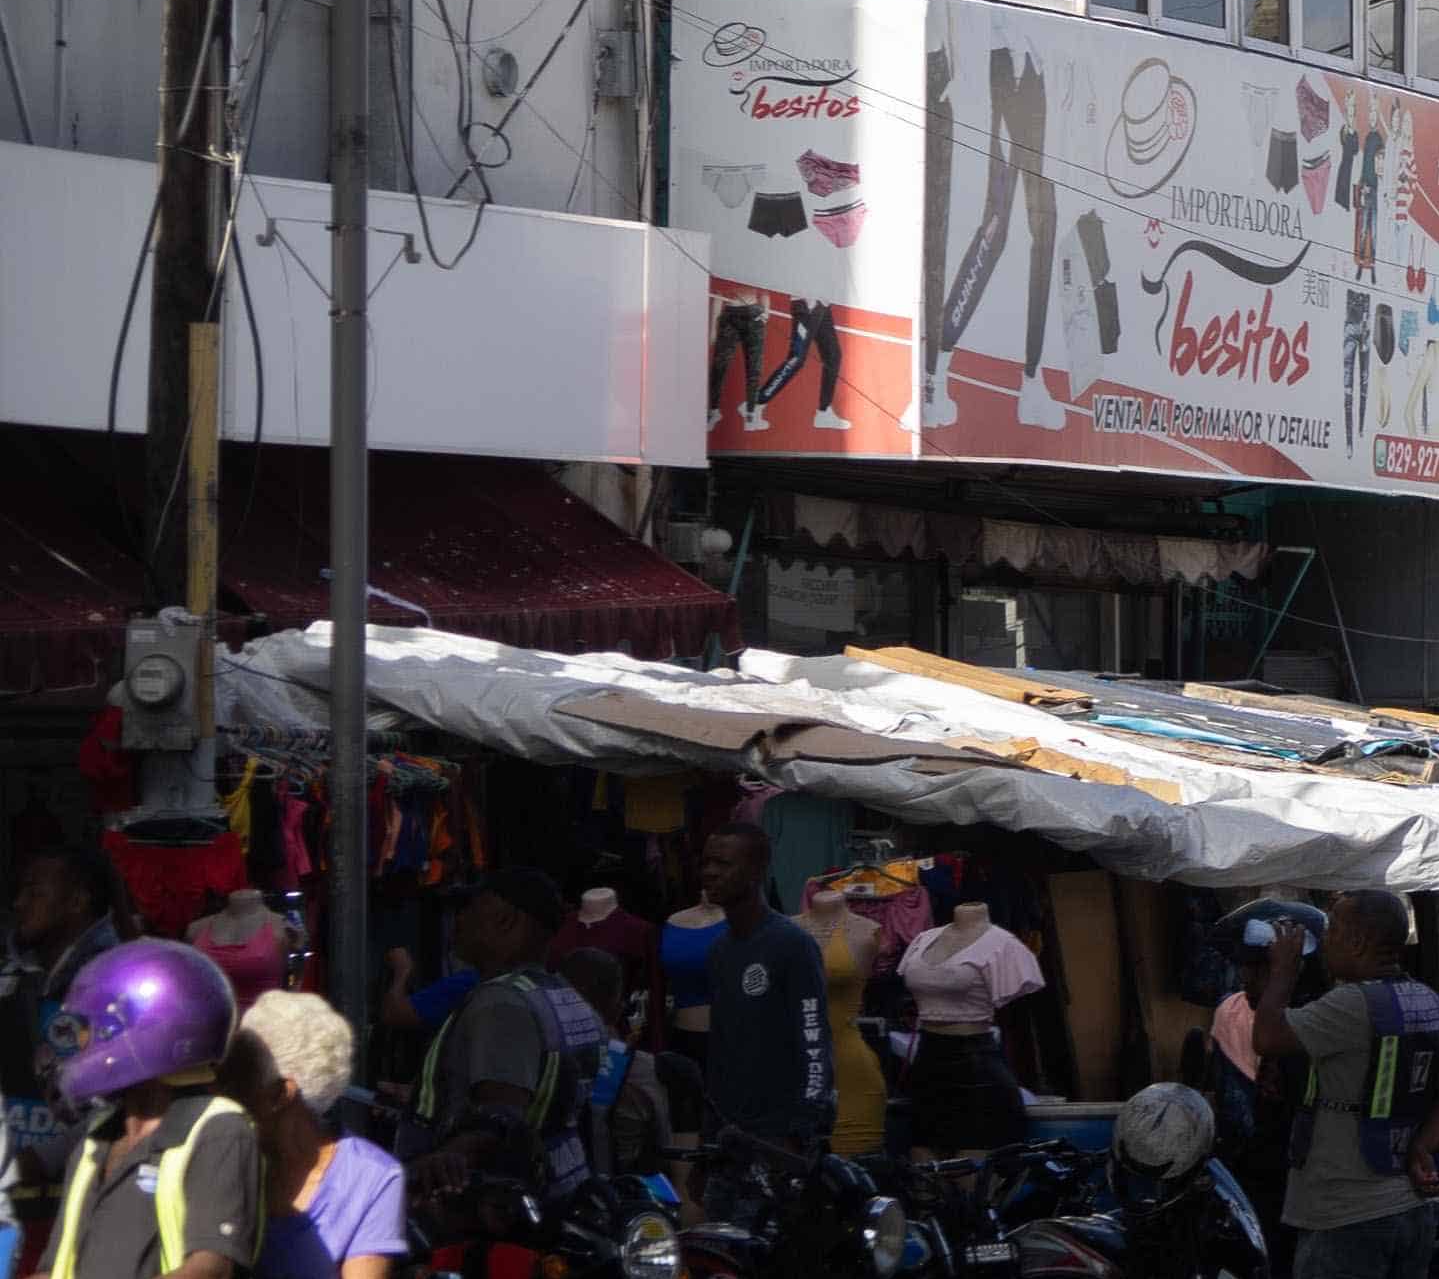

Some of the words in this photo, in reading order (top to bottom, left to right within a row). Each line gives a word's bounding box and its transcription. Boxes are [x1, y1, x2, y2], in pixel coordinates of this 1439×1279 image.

[749, 59, 852, 72] IMPORTADORA
[752, 86, 860, 119] besitos
[1171, 185, 1304, 241] IMPORTADORA
[1169, 271, 1310, 386] besitos
[1094, 396, 1143, 431] VENTA
[1150, 400, 1168, 433] AL
[1174, 403, 1204, 435] POR
[1207, 407, 1261, 441] MAYOR
[1267, 414, 1275, 442] Y
[1278, 415, 1330, 449] DETALLE
[801, 997, 822, 1042] NEW
[804, 1048, 825, 1100] YORK
